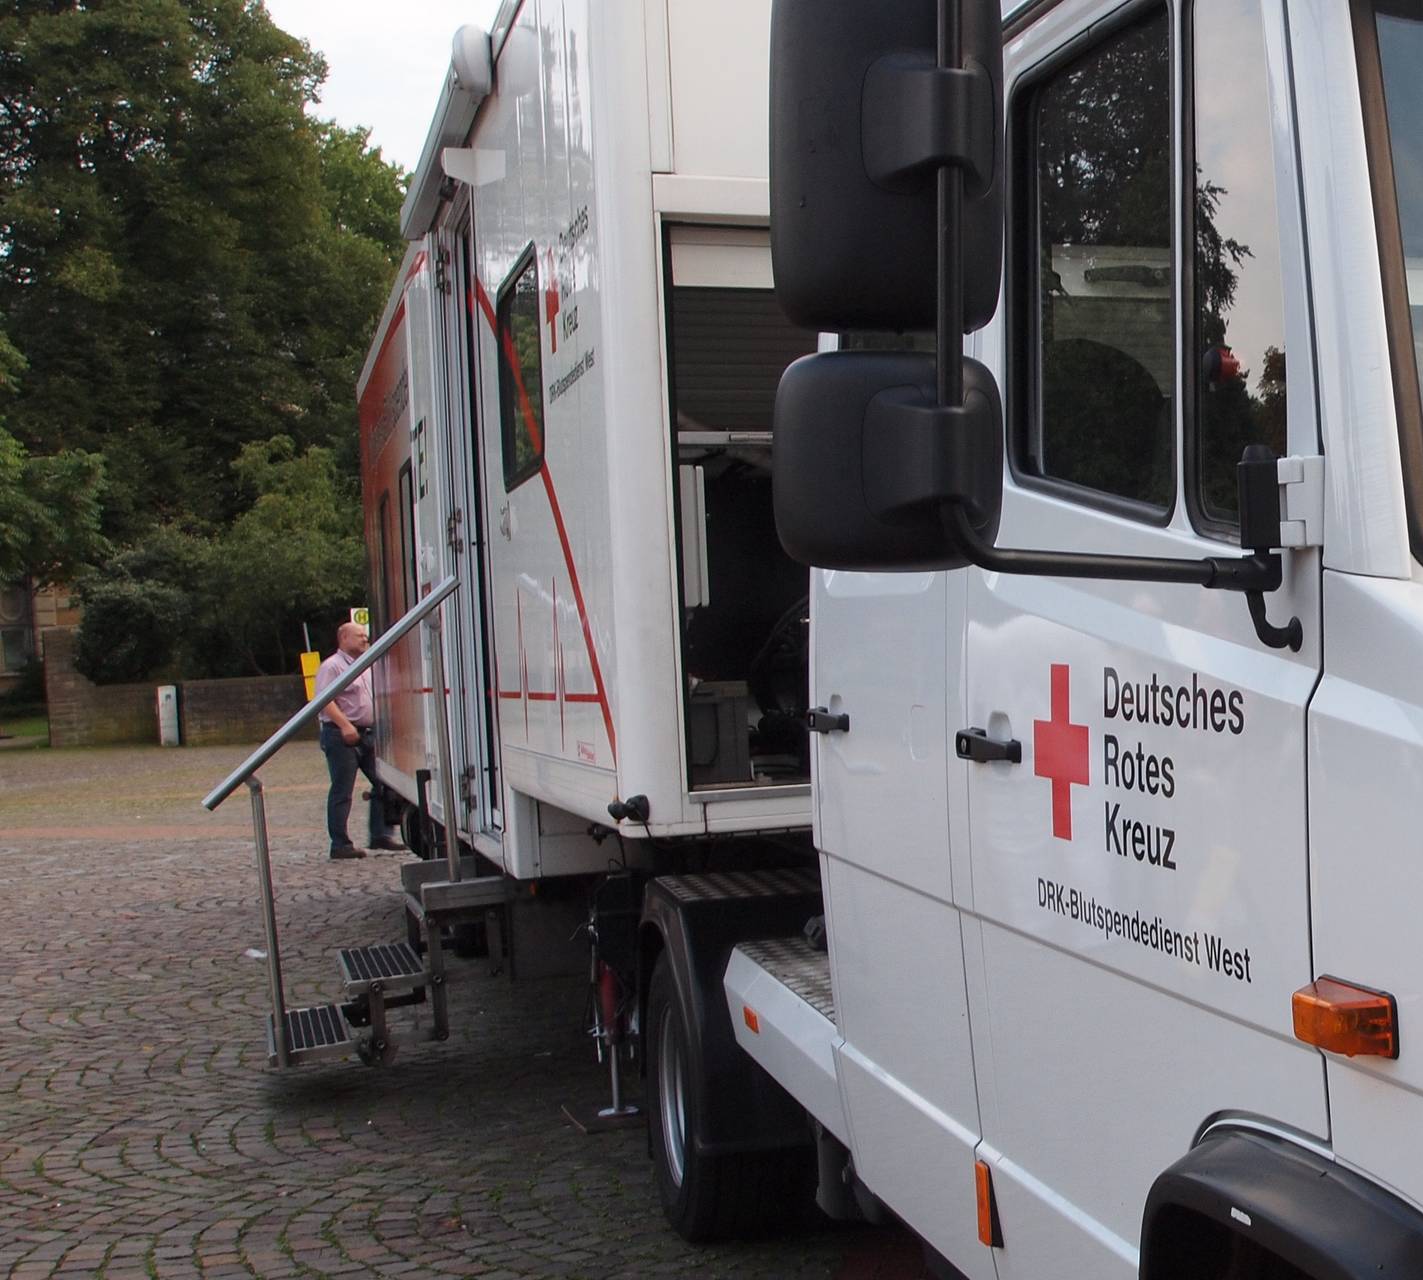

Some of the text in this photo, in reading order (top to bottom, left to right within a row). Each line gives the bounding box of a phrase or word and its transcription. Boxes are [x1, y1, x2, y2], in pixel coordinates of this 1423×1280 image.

[563, 304, 579, 342] Kreuz
[1103, 667, 1245, 735] Deutsches
[1104, 734, 1175, 799] Rotes
[1105, 801, 1177, 871] Kreuz
[1038, 877, 1252, 984] DRK-Blutspendedienst West
